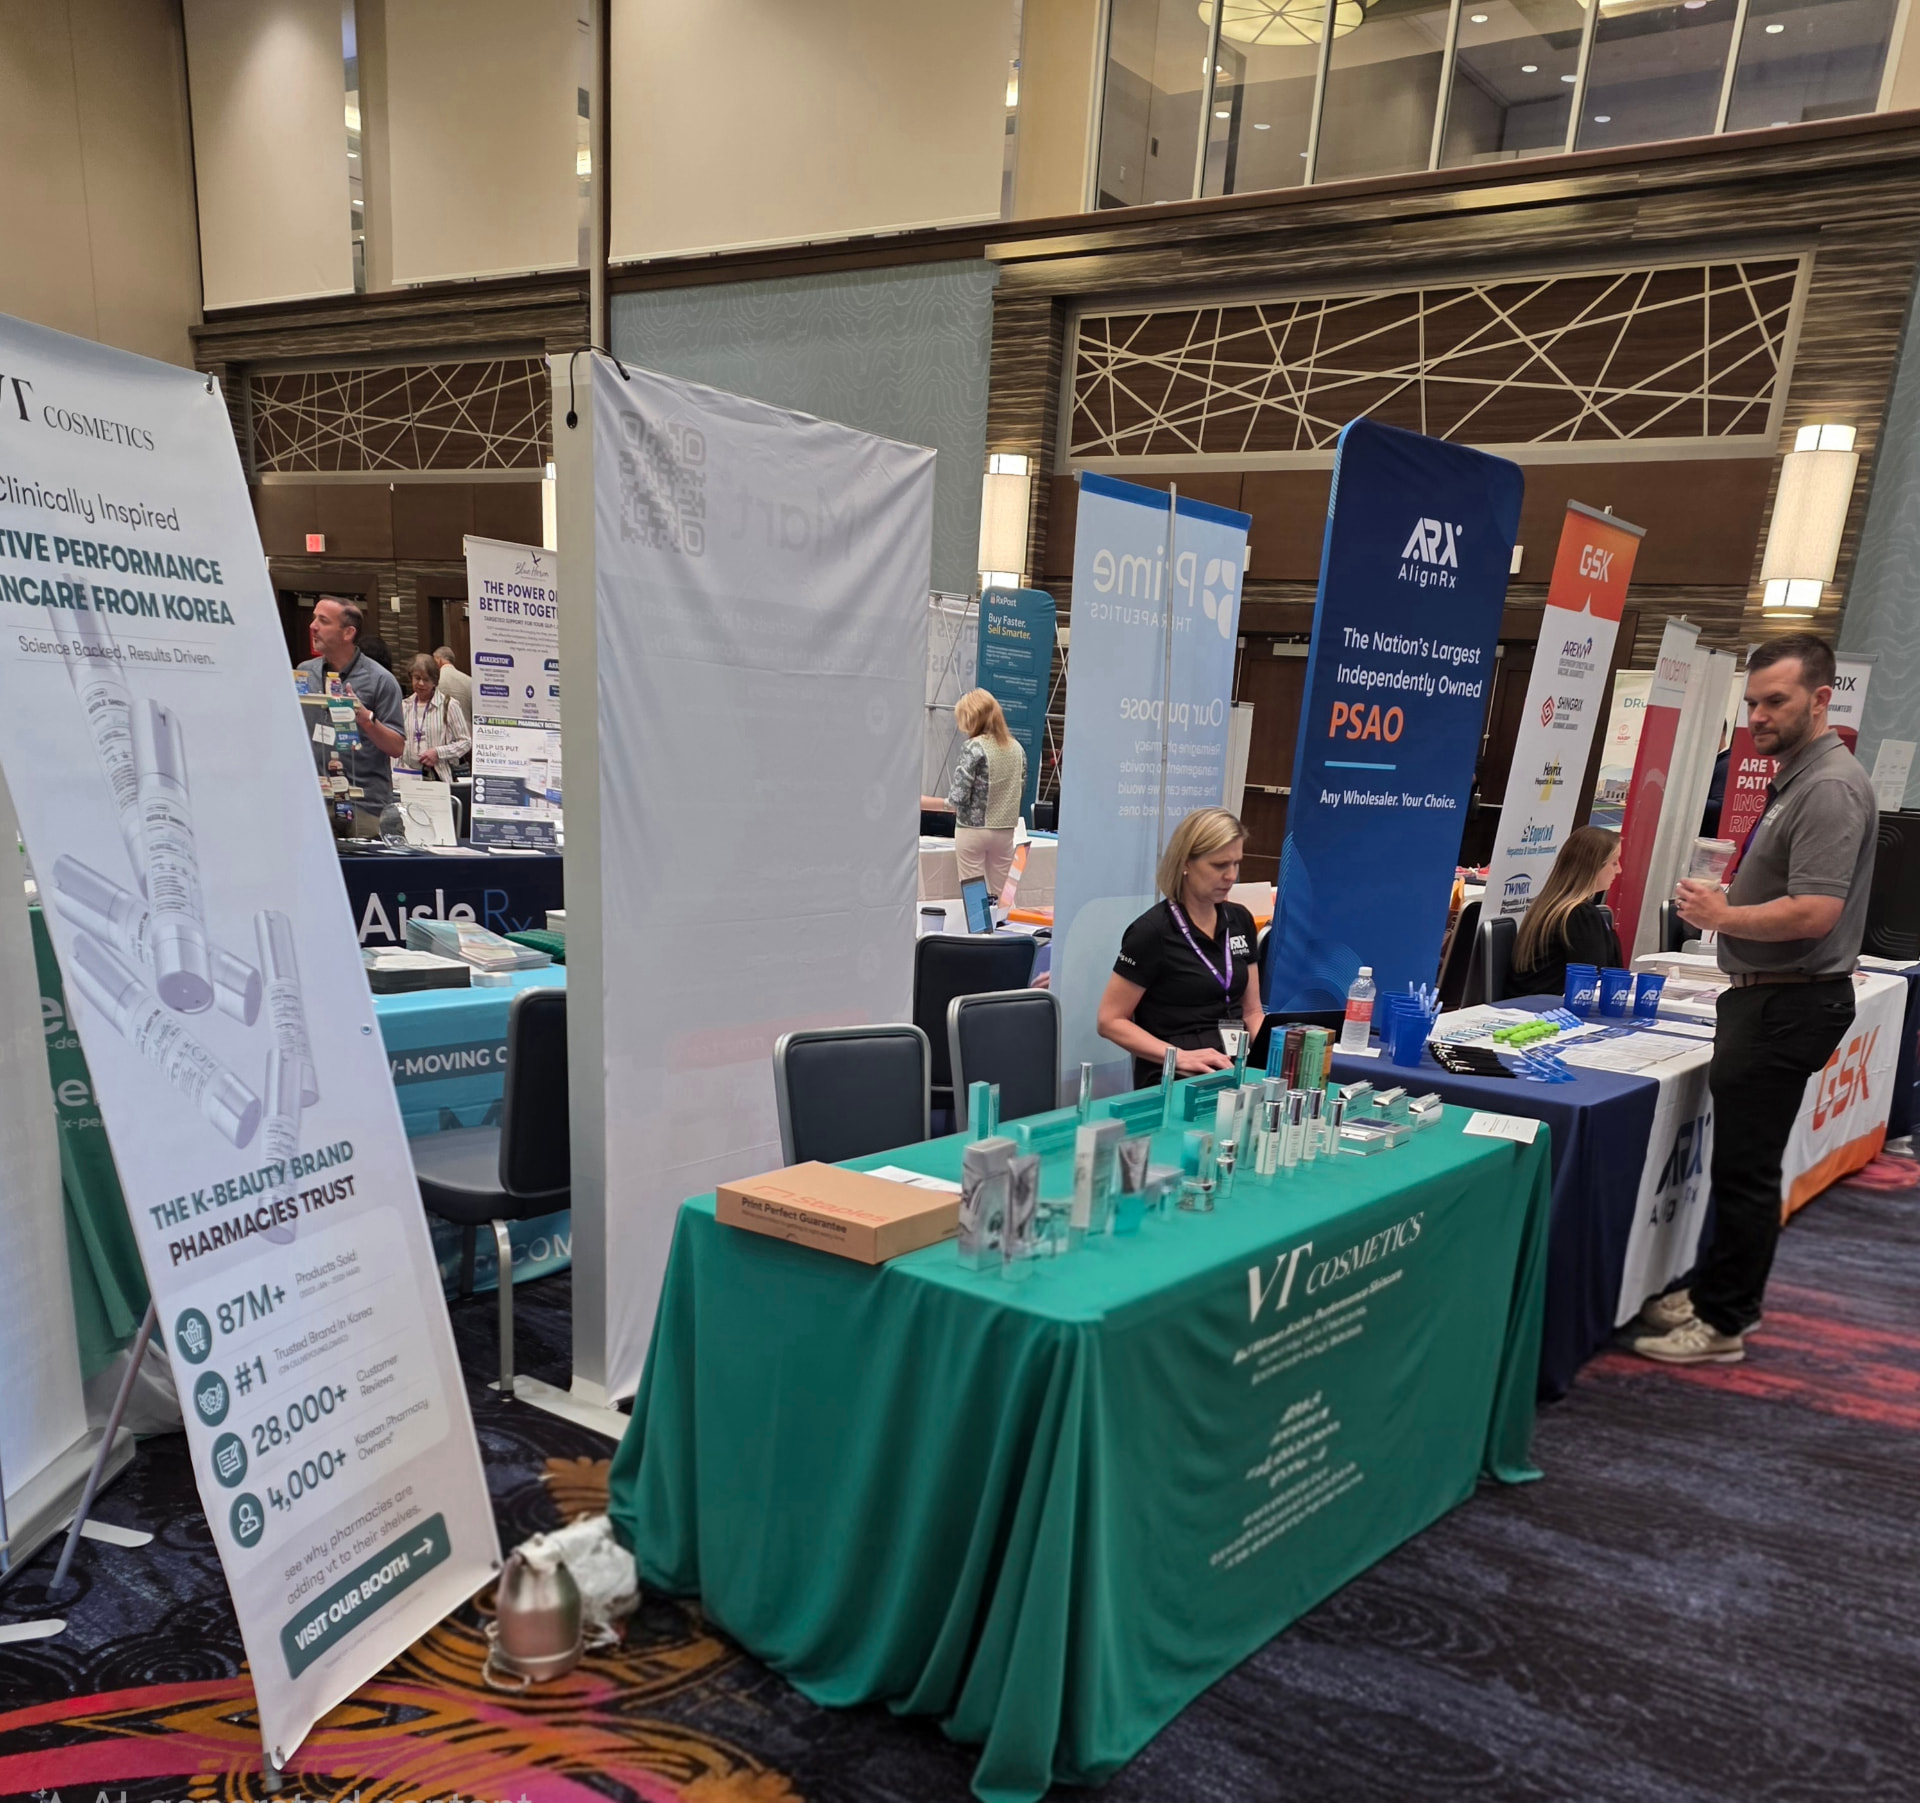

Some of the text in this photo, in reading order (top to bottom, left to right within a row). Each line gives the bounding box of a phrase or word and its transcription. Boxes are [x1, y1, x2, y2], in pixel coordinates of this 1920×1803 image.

[0, 374, 155, 451] T COSMETICS
[98, 493, 181, 532] Inspired
[53, 536, 224, 586] PERFORMANCE
[1401, 517, 1462, 568] ARX
[1579, 543, 1614, 583] GSK
[484, 580, 504, 596] THE
[507, 583, 545, 601] POWER
[1398, 562, 1456, 588] AlignRx
[0, 574, 235, 625] NCARE FROM KOREA
[480, 597, 559, 619] BETTER TOGET
[987, 623, 1000, 635] Sell
[1002, 627, 1031, 640] Smarter.
[988, 612, 1026, 629] Buy Faster.
[19, 635, 215, 665] Science Backed, Results Driven.
[1343, 627, 1480, 666] The Nation's Largest
[1337, 663, 1482, 698] Independently Owned
[1328, 701, 1404, 743] PSAO
[1736, 775, 1772, 790] PATI
[1738, 758, 1768, 773] ARE
[1320, 789, 1457, 809] Any Wholesaler. Your Choice.
[149, 1140, 354, 1231] THE K-BEAUTY BRAND
[168, 1175, 355, 1267] PHARMACIES TRUST
[742, 1197, 763, 1212] Print
[764, 1203, 797, 1221] Perfect
[799, 1212, 847, 1234] Guarantee
[295, 1262, 336, 1286] Products
[336, 1249, 358, 1268] Sold
[1248, 1211, 1424, 1324] VT COSMETICS
[216, 1283, 286, 1335] 87M+
[274, 1337, 308, 1361] Trusted
[308, 1323, 337, 1344] Brand
[347, 1306, 373, 1325] Korea
[234, 1355, 267, 1397] #1
[356, 1354, 399, 1383] Customer
[360, 1374, 394, 1398] Reviews
[252, 1384, 347, 1457] 28,000+
[354, 1398, 430, 1447] Korean Pharmacy
[267, 1449, 347, 1512] 4,000+
[284, 1484, 413, 1581] see why pharmacies are
[288, 1570, 325, 1605] adding
[339, 1549, 351, 1564] to
[353, 1531, 378, 1556] their
[380, 1503, 422, 1537] shelves.
[294, 1616, 328, 1651] VISIT
[328, 1590, 361, 1623] OUR
[360, 1553, 411, 1601] BOOTH
